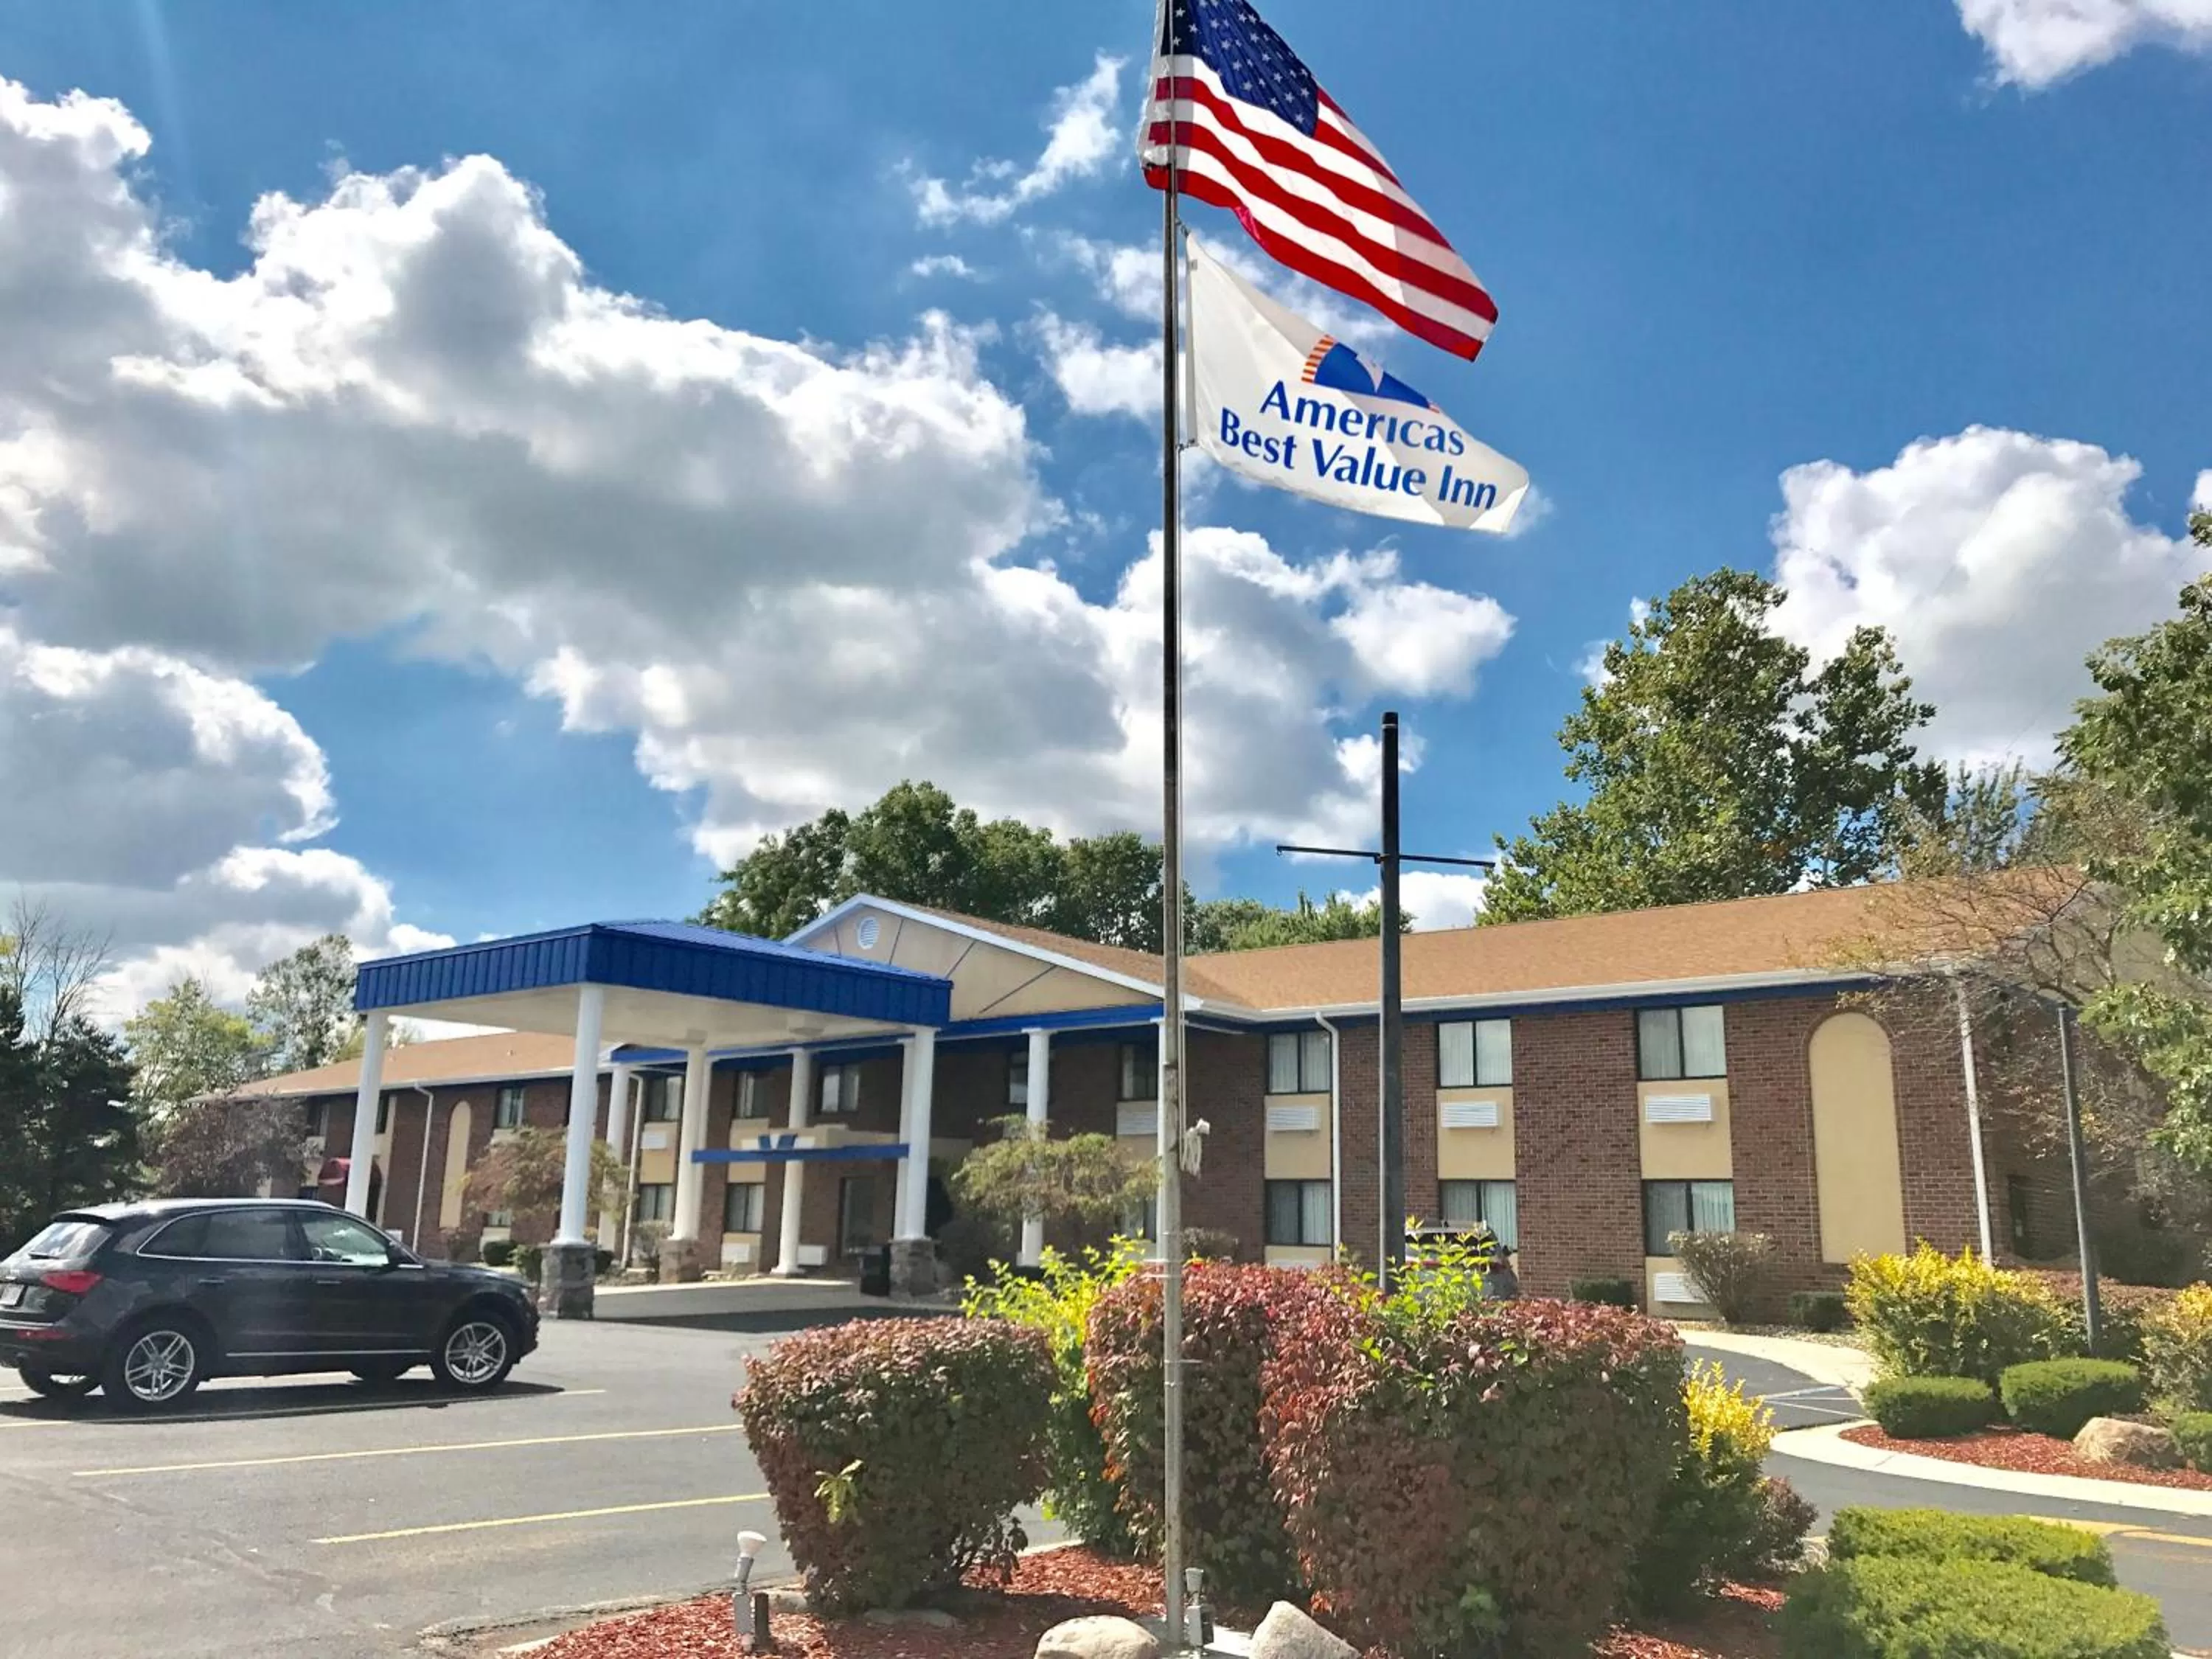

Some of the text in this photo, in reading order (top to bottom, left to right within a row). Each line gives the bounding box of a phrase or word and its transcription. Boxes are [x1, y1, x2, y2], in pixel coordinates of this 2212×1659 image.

[1220, 407, 1497, 510] Best Value Inn
[1259, 380, 1465, 456] Americas
